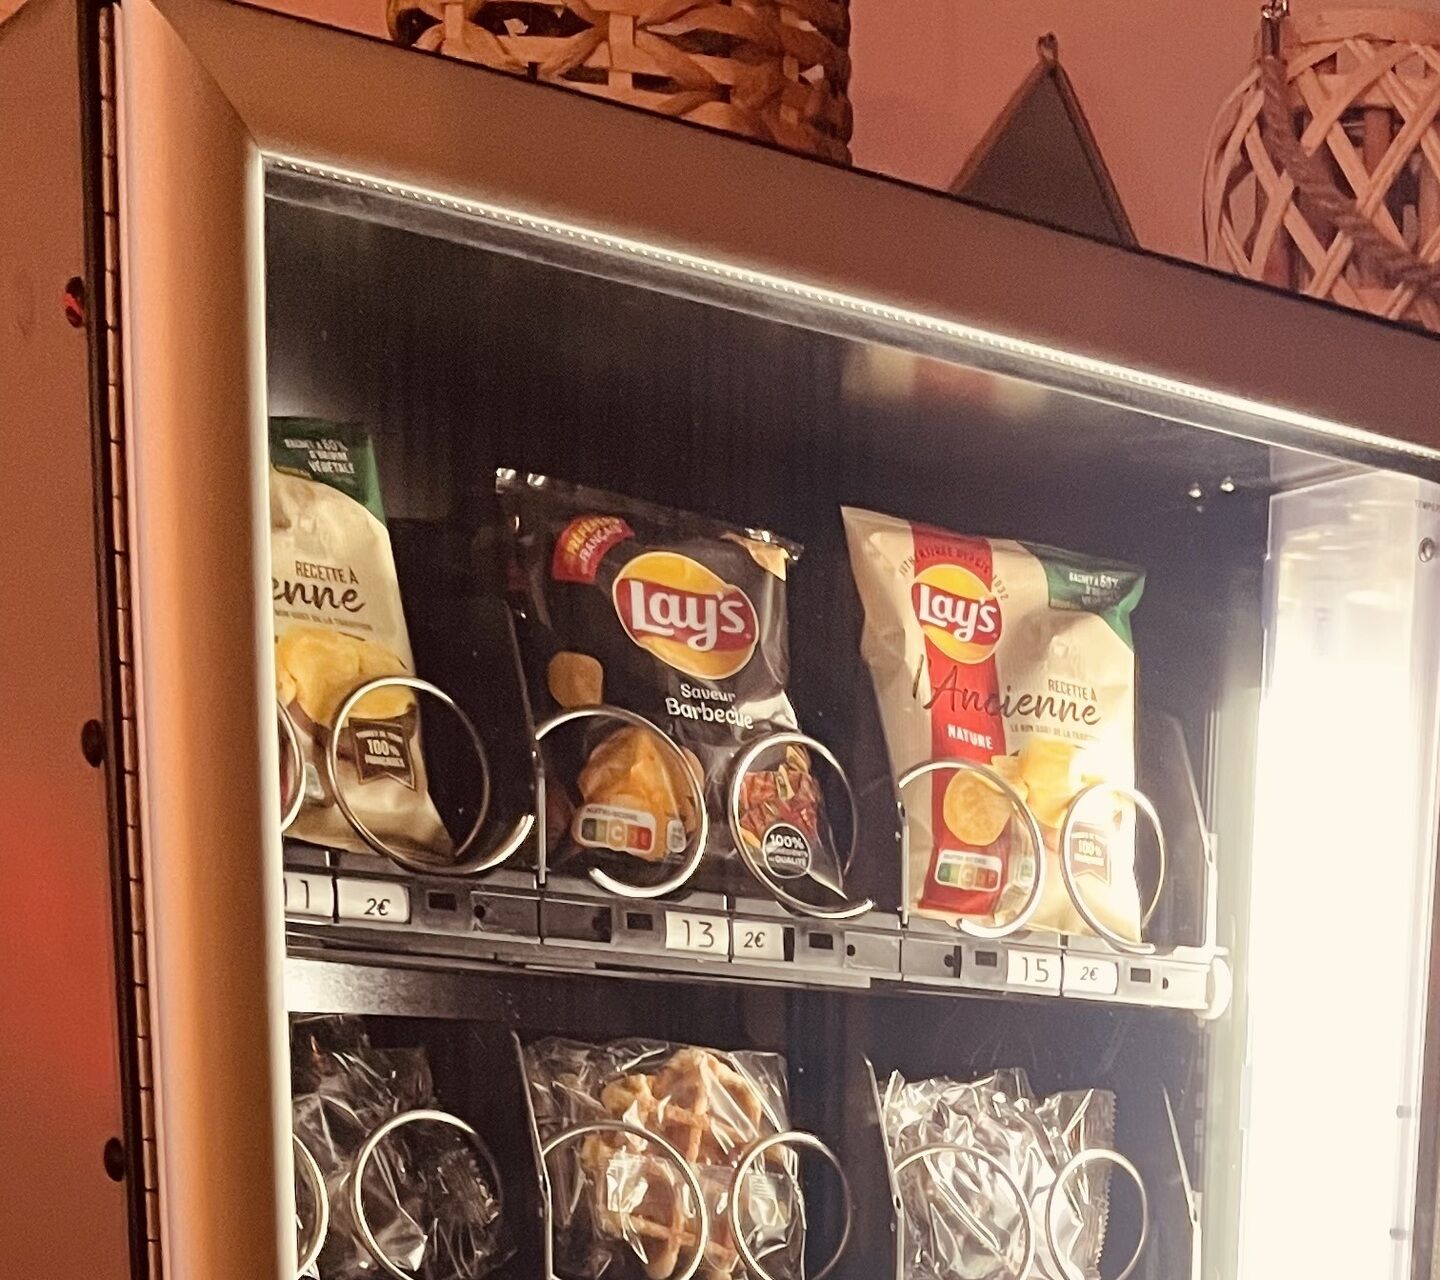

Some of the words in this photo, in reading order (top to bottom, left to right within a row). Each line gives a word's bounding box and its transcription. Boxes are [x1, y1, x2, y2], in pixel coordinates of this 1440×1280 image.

[295, 560, 347, 583] RECETTE
[629, 580, 746, 651] Lay's
[918, 581, 998, 643] Lay's
[680, 682, 736, 703] Saveur
[1047, 678, 1089, 700] RECETTE
[664, 697, 754, 730] Barbecue
[946, 722, 994, 749] NATURE
[769, 833, 805, 850] 100%
[363, 897, 391, 917] 2€
[683, 919, 715, 948] 13
[743, 930, 766, 949] 2€
[1021, 956, 1050, 983] 15
[1079, 965, 1099, 981] 2€
